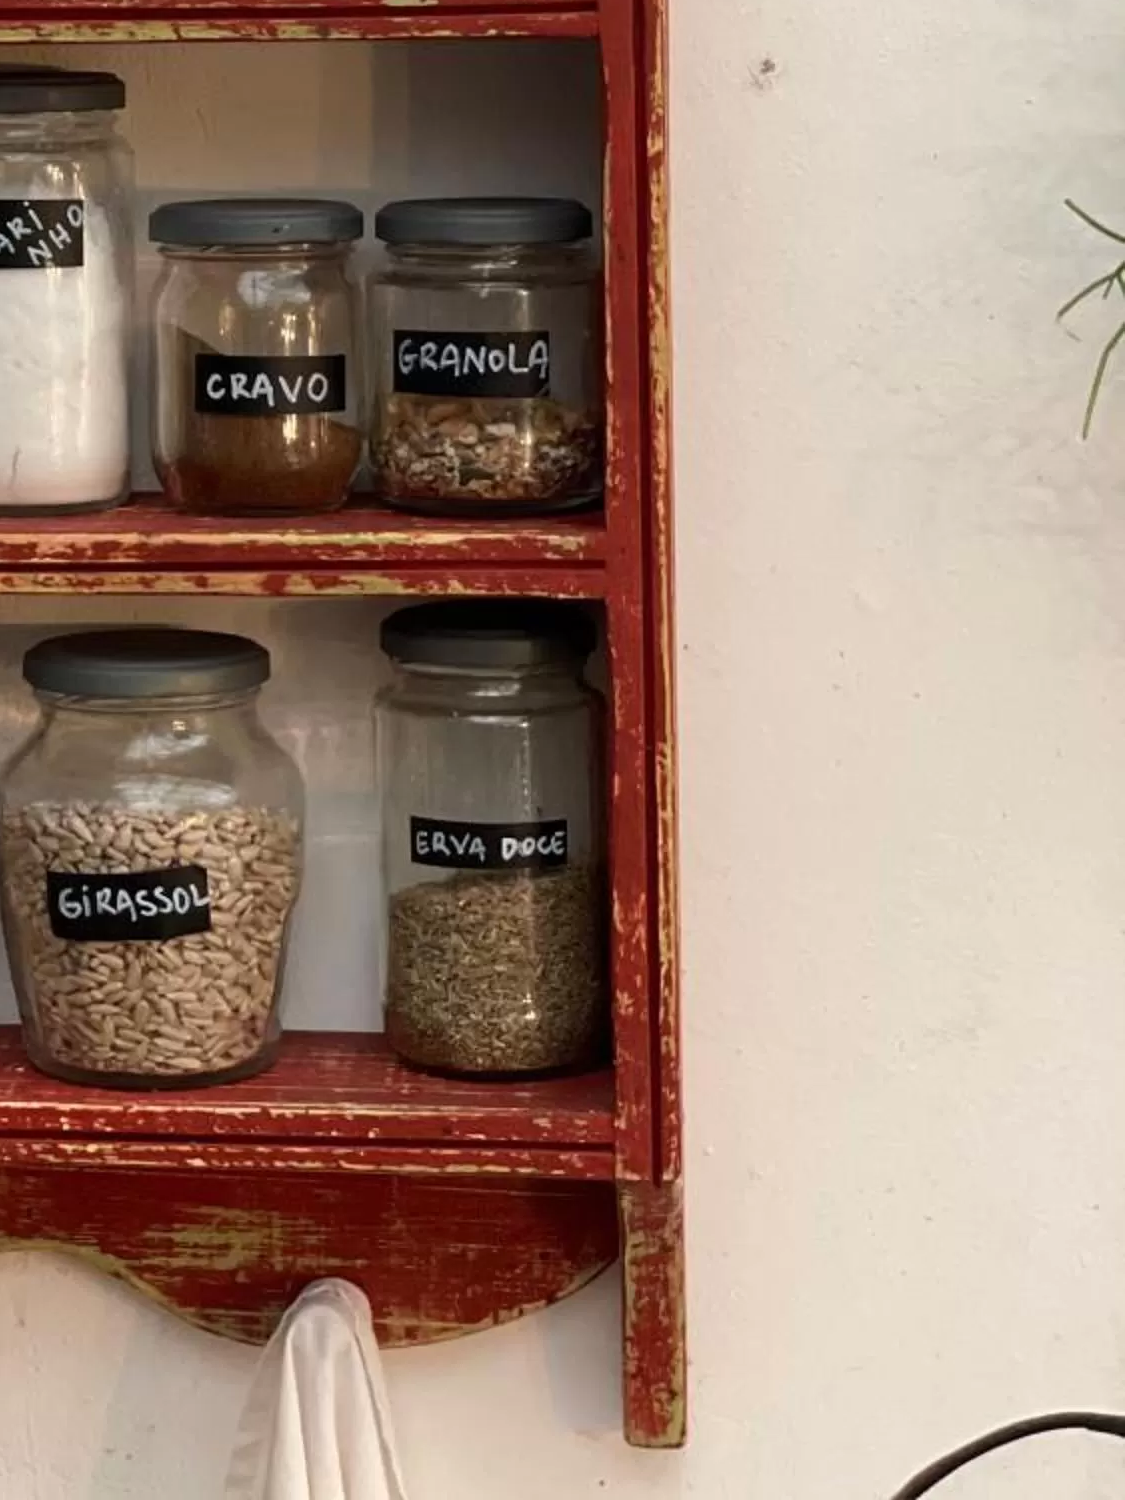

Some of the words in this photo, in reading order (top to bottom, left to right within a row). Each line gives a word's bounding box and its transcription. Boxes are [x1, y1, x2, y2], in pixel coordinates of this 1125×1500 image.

[398, 338, 549, 379] GRANOLA
[206, 372, 329, 408] CRAVO
[415, 830, 487, 862] ERVA
[501, 831, 566, 861] DOCE
